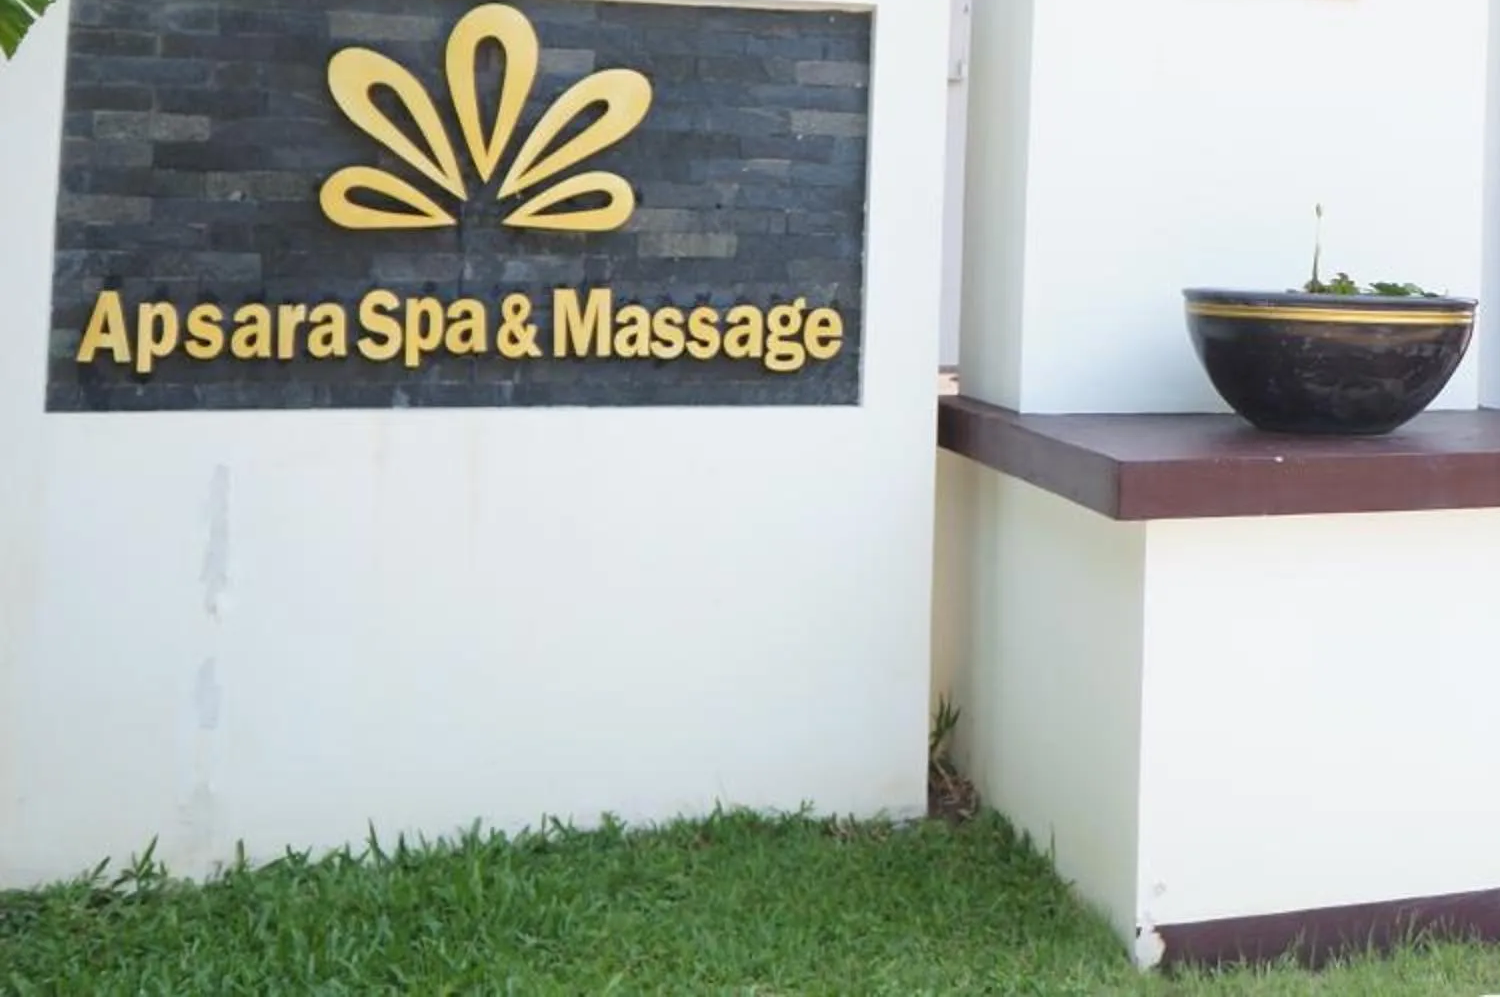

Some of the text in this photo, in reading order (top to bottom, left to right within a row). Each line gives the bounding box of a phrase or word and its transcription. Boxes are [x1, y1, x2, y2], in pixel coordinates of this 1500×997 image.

[76, 288, 843, 373] Apsara Spa & Massage
